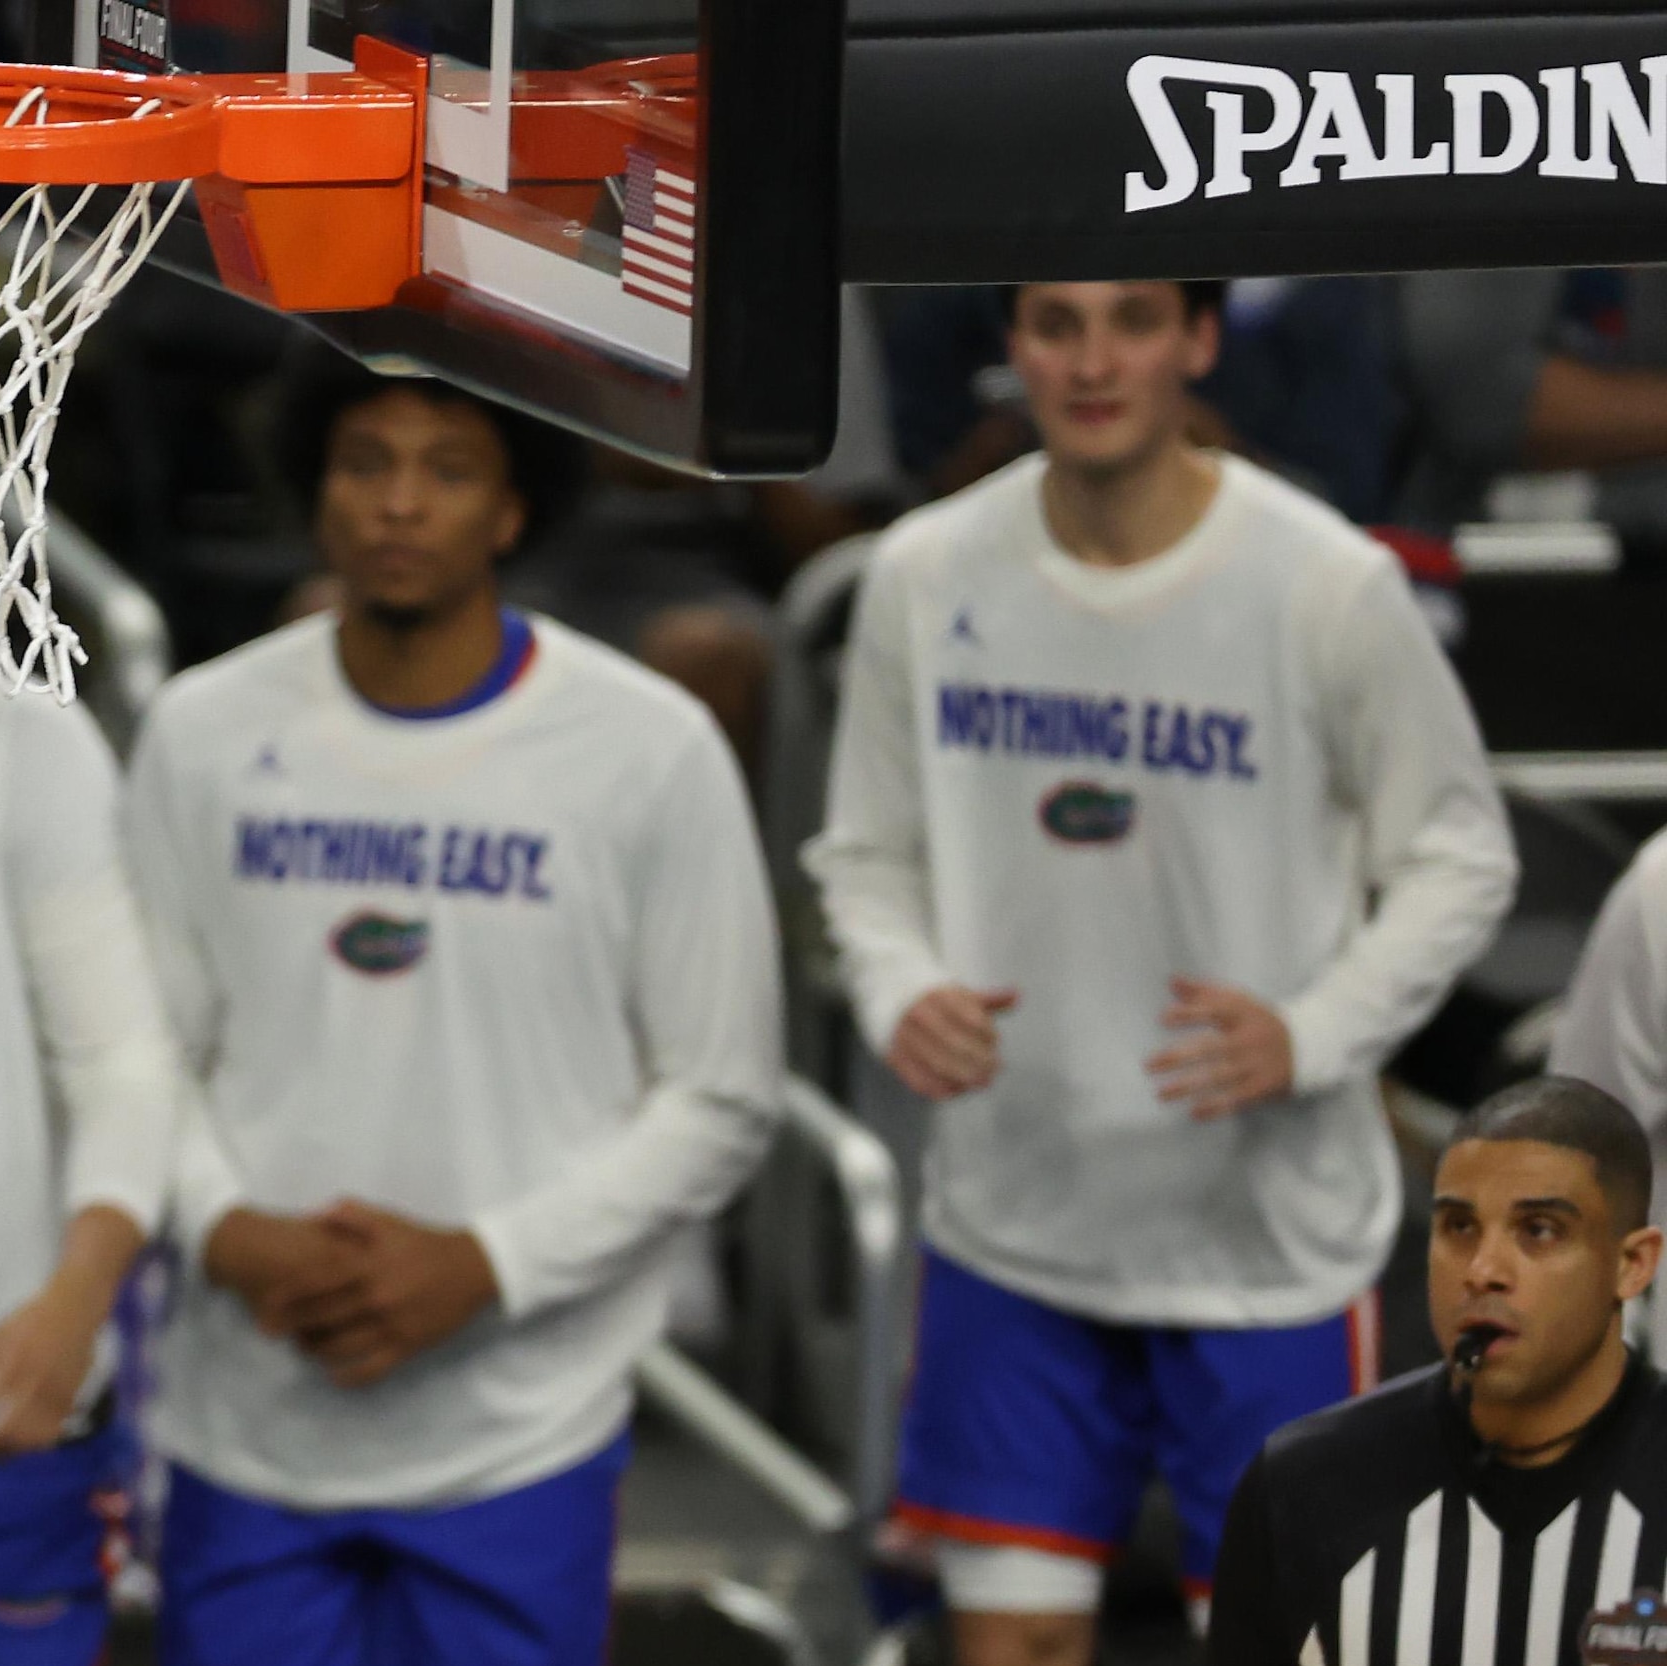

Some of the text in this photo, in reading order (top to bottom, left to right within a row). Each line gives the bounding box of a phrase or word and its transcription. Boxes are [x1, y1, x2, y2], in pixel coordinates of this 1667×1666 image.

[1125, 54, 1667, 214] SPALDIN
[936, 682, 1259, 782] NOTHING EASY.
[233, 813, 430, 887] NOTHING
[1643, 1623, 1667, 1653] FO
